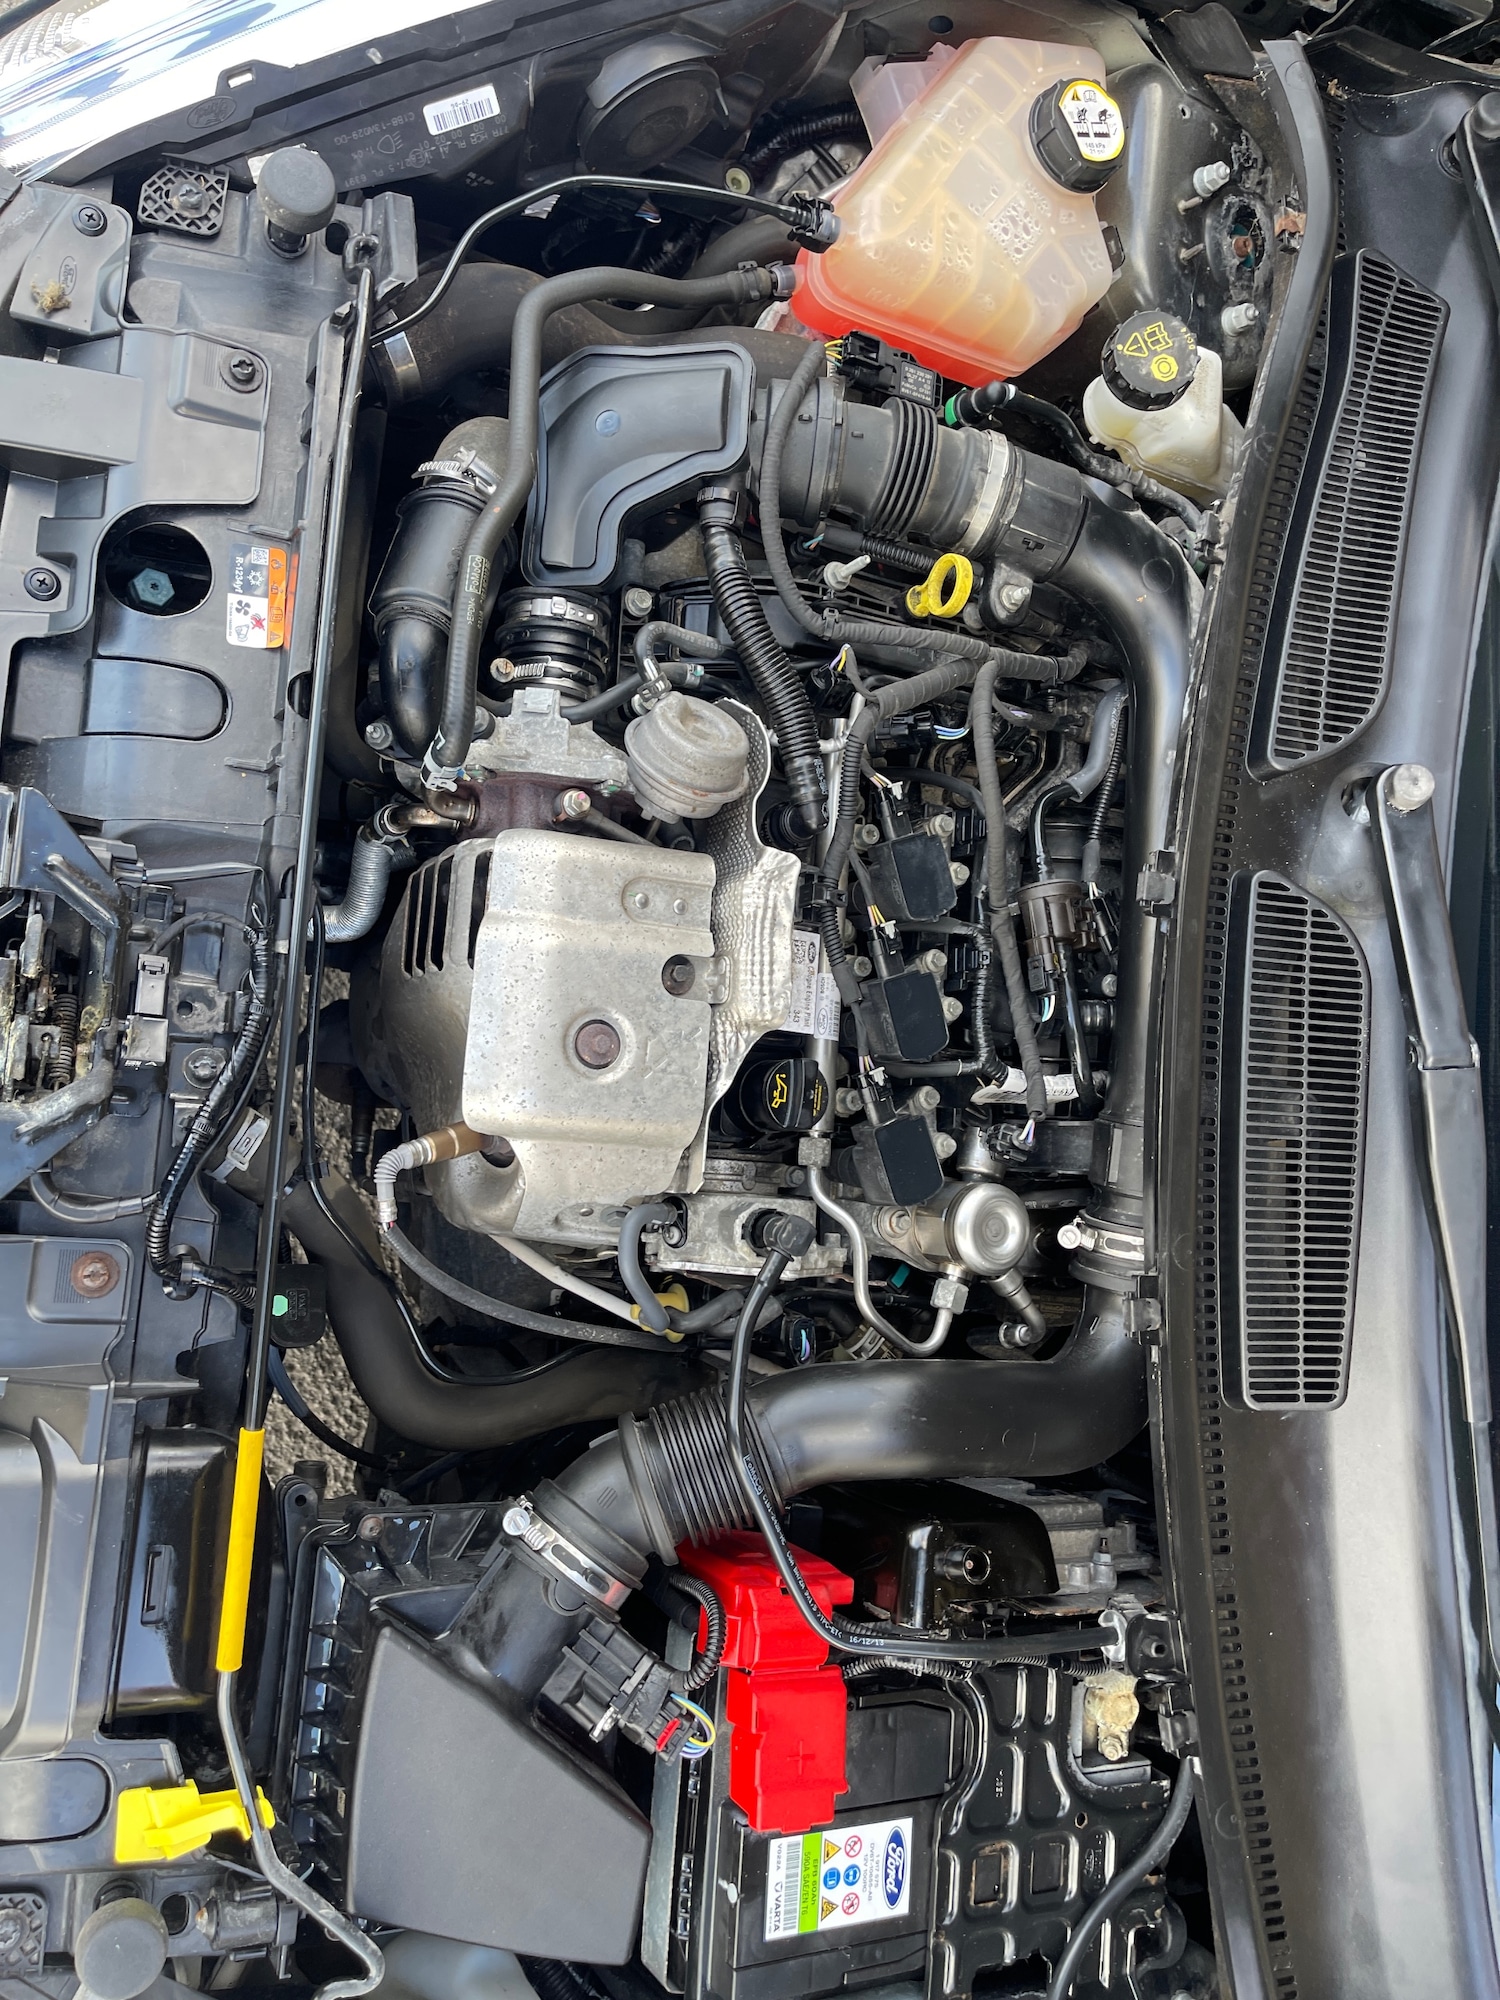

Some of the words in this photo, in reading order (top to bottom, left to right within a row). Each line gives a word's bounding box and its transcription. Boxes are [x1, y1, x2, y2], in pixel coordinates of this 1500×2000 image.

[233, 556, 244, 594] R-1234yf
[469, 555, 483, 593] FoMoCo
[804, 990, 813, 1010] Engine
[793, 1009, 801, 1023] 343
[803, 1011, 812, 1028] Plant
[849, 1636, 885, 1647] 16/12/13
[803, 1851, 811, 1872] 590A
[802, 1874, 810, 1904] SAE/EN
[811, 1880, 819, 1906] 60Ah
[773, 1893, 783, 1933] VARTA
[801, 1905, 808, 1916] T6
